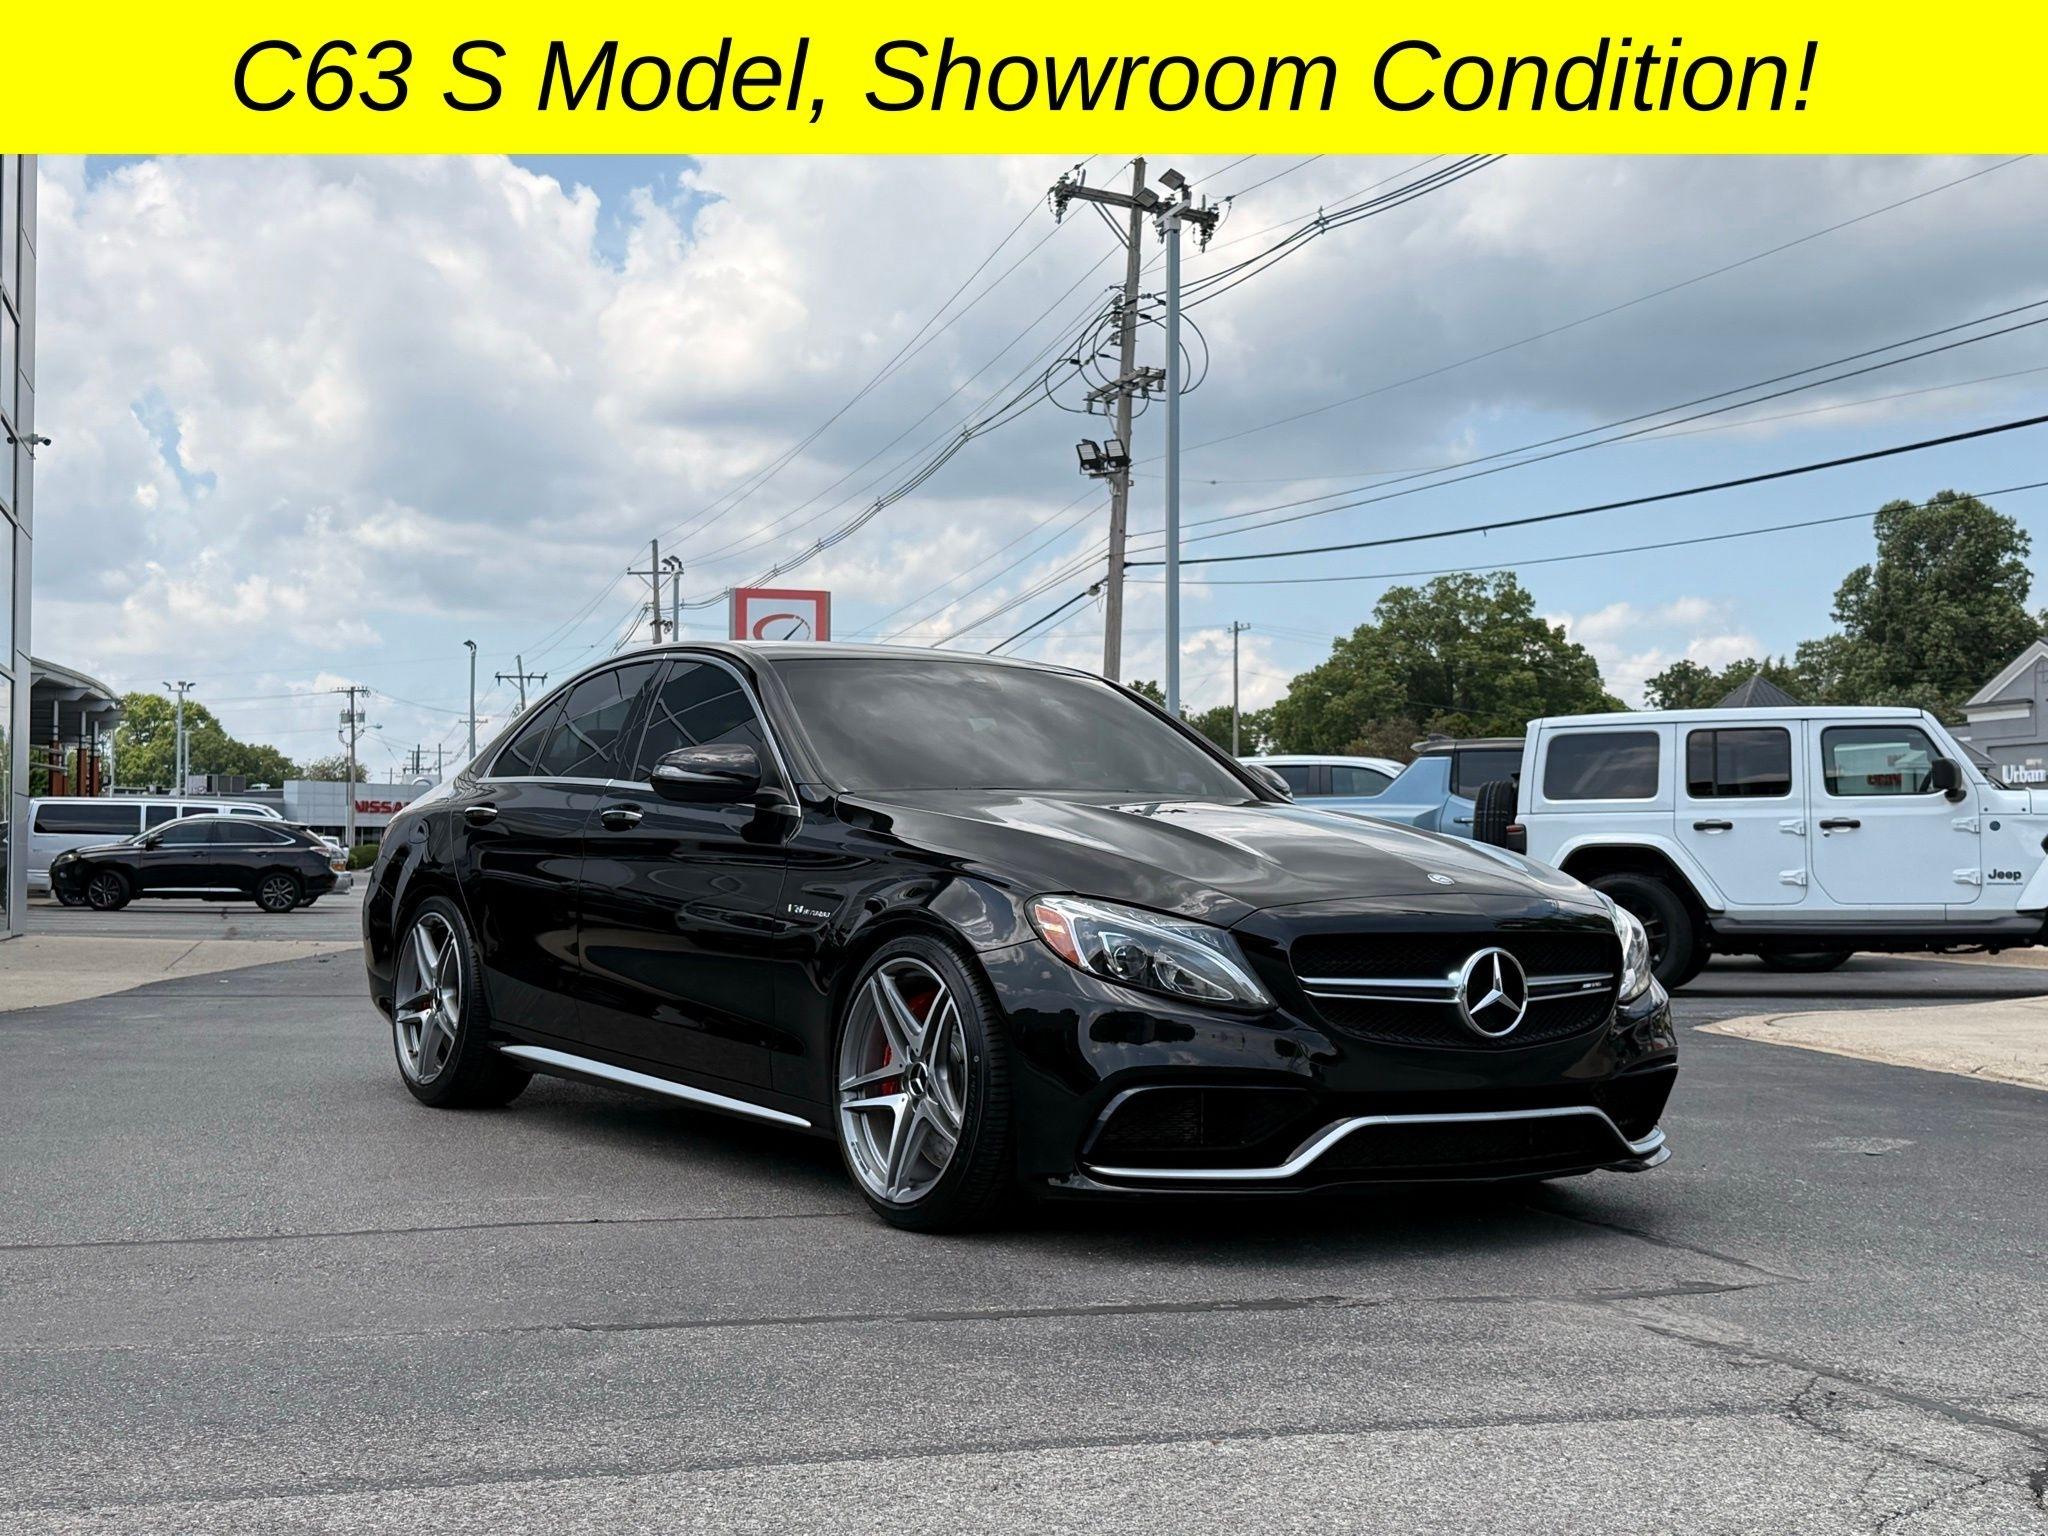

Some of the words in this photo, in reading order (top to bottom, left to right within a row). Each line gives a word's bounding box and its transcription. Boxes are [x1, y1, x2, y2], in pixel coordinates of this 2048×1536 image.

[2002, 765, 2046, 784] Urban
[355, 800, 411, 814] NISSA
[1988, 869, 2022, 881] Jeep
